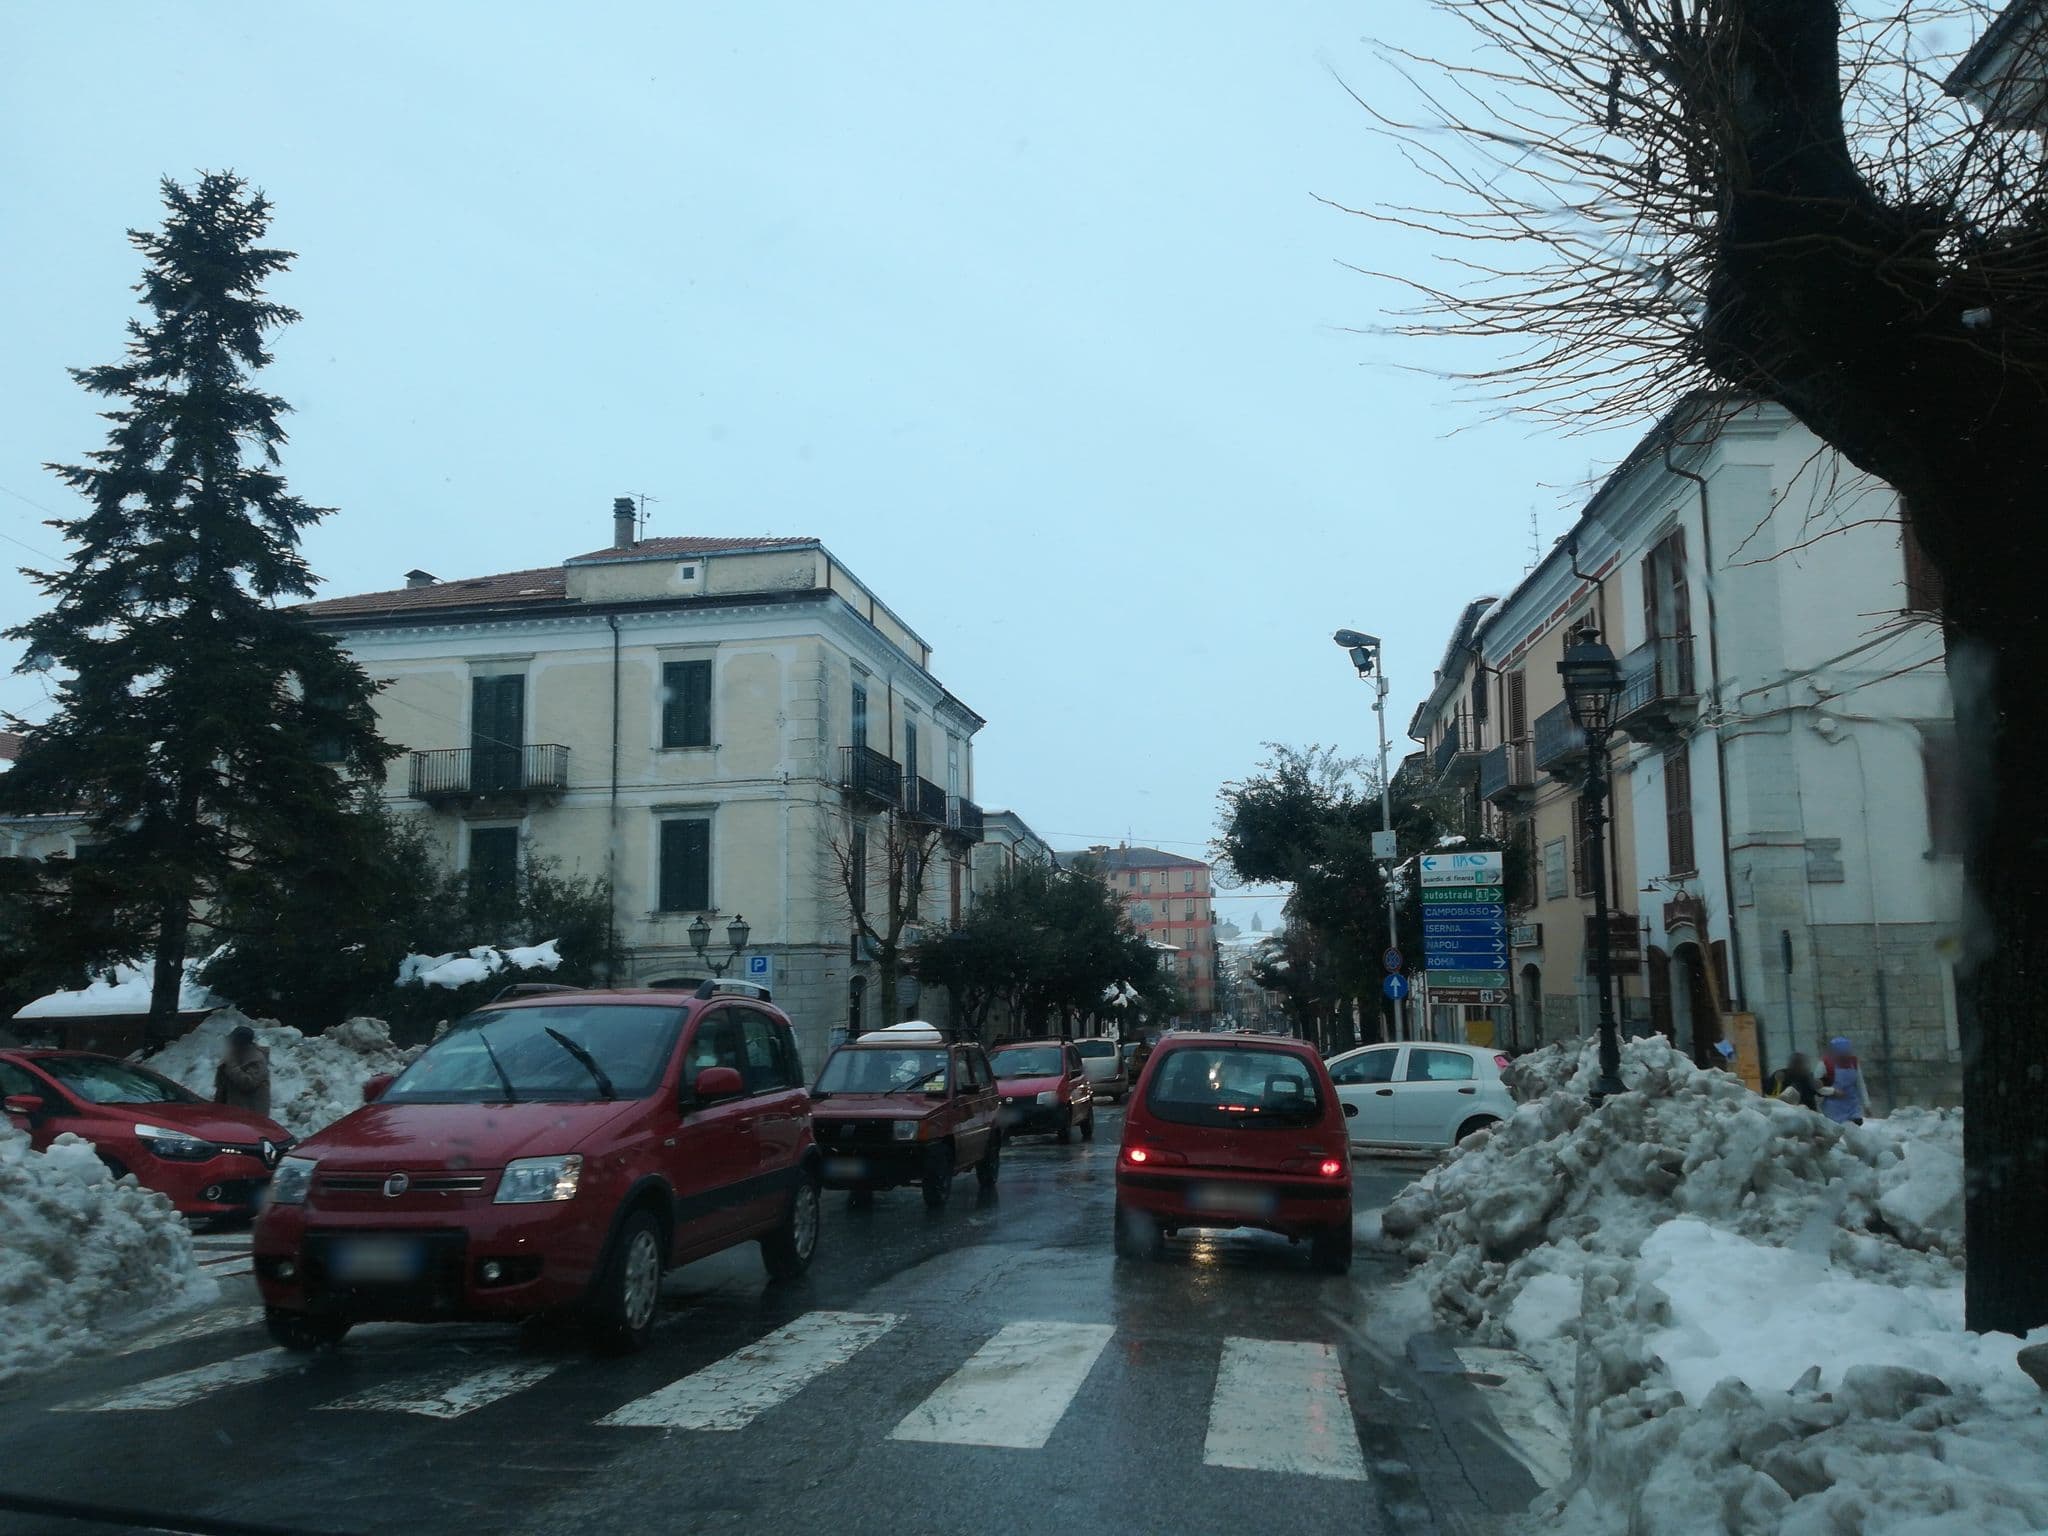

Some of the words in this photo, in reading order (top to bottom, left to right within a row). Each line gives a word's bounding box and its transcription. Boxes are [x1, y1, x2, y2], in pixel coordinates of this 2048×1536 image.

[1454, 874, 1474, 882] finanza
[1424, 890, 1473, 899] autostrada
[1425, 908, 1489, 916] CAMPOBASSO
[1425, 924, 1462, 933] ISERNIA
[1426, 940, 1459, 949] NAPOLI
[754, 959, 764, 971] P
[1427, 957, 1455, 966] ROMA
